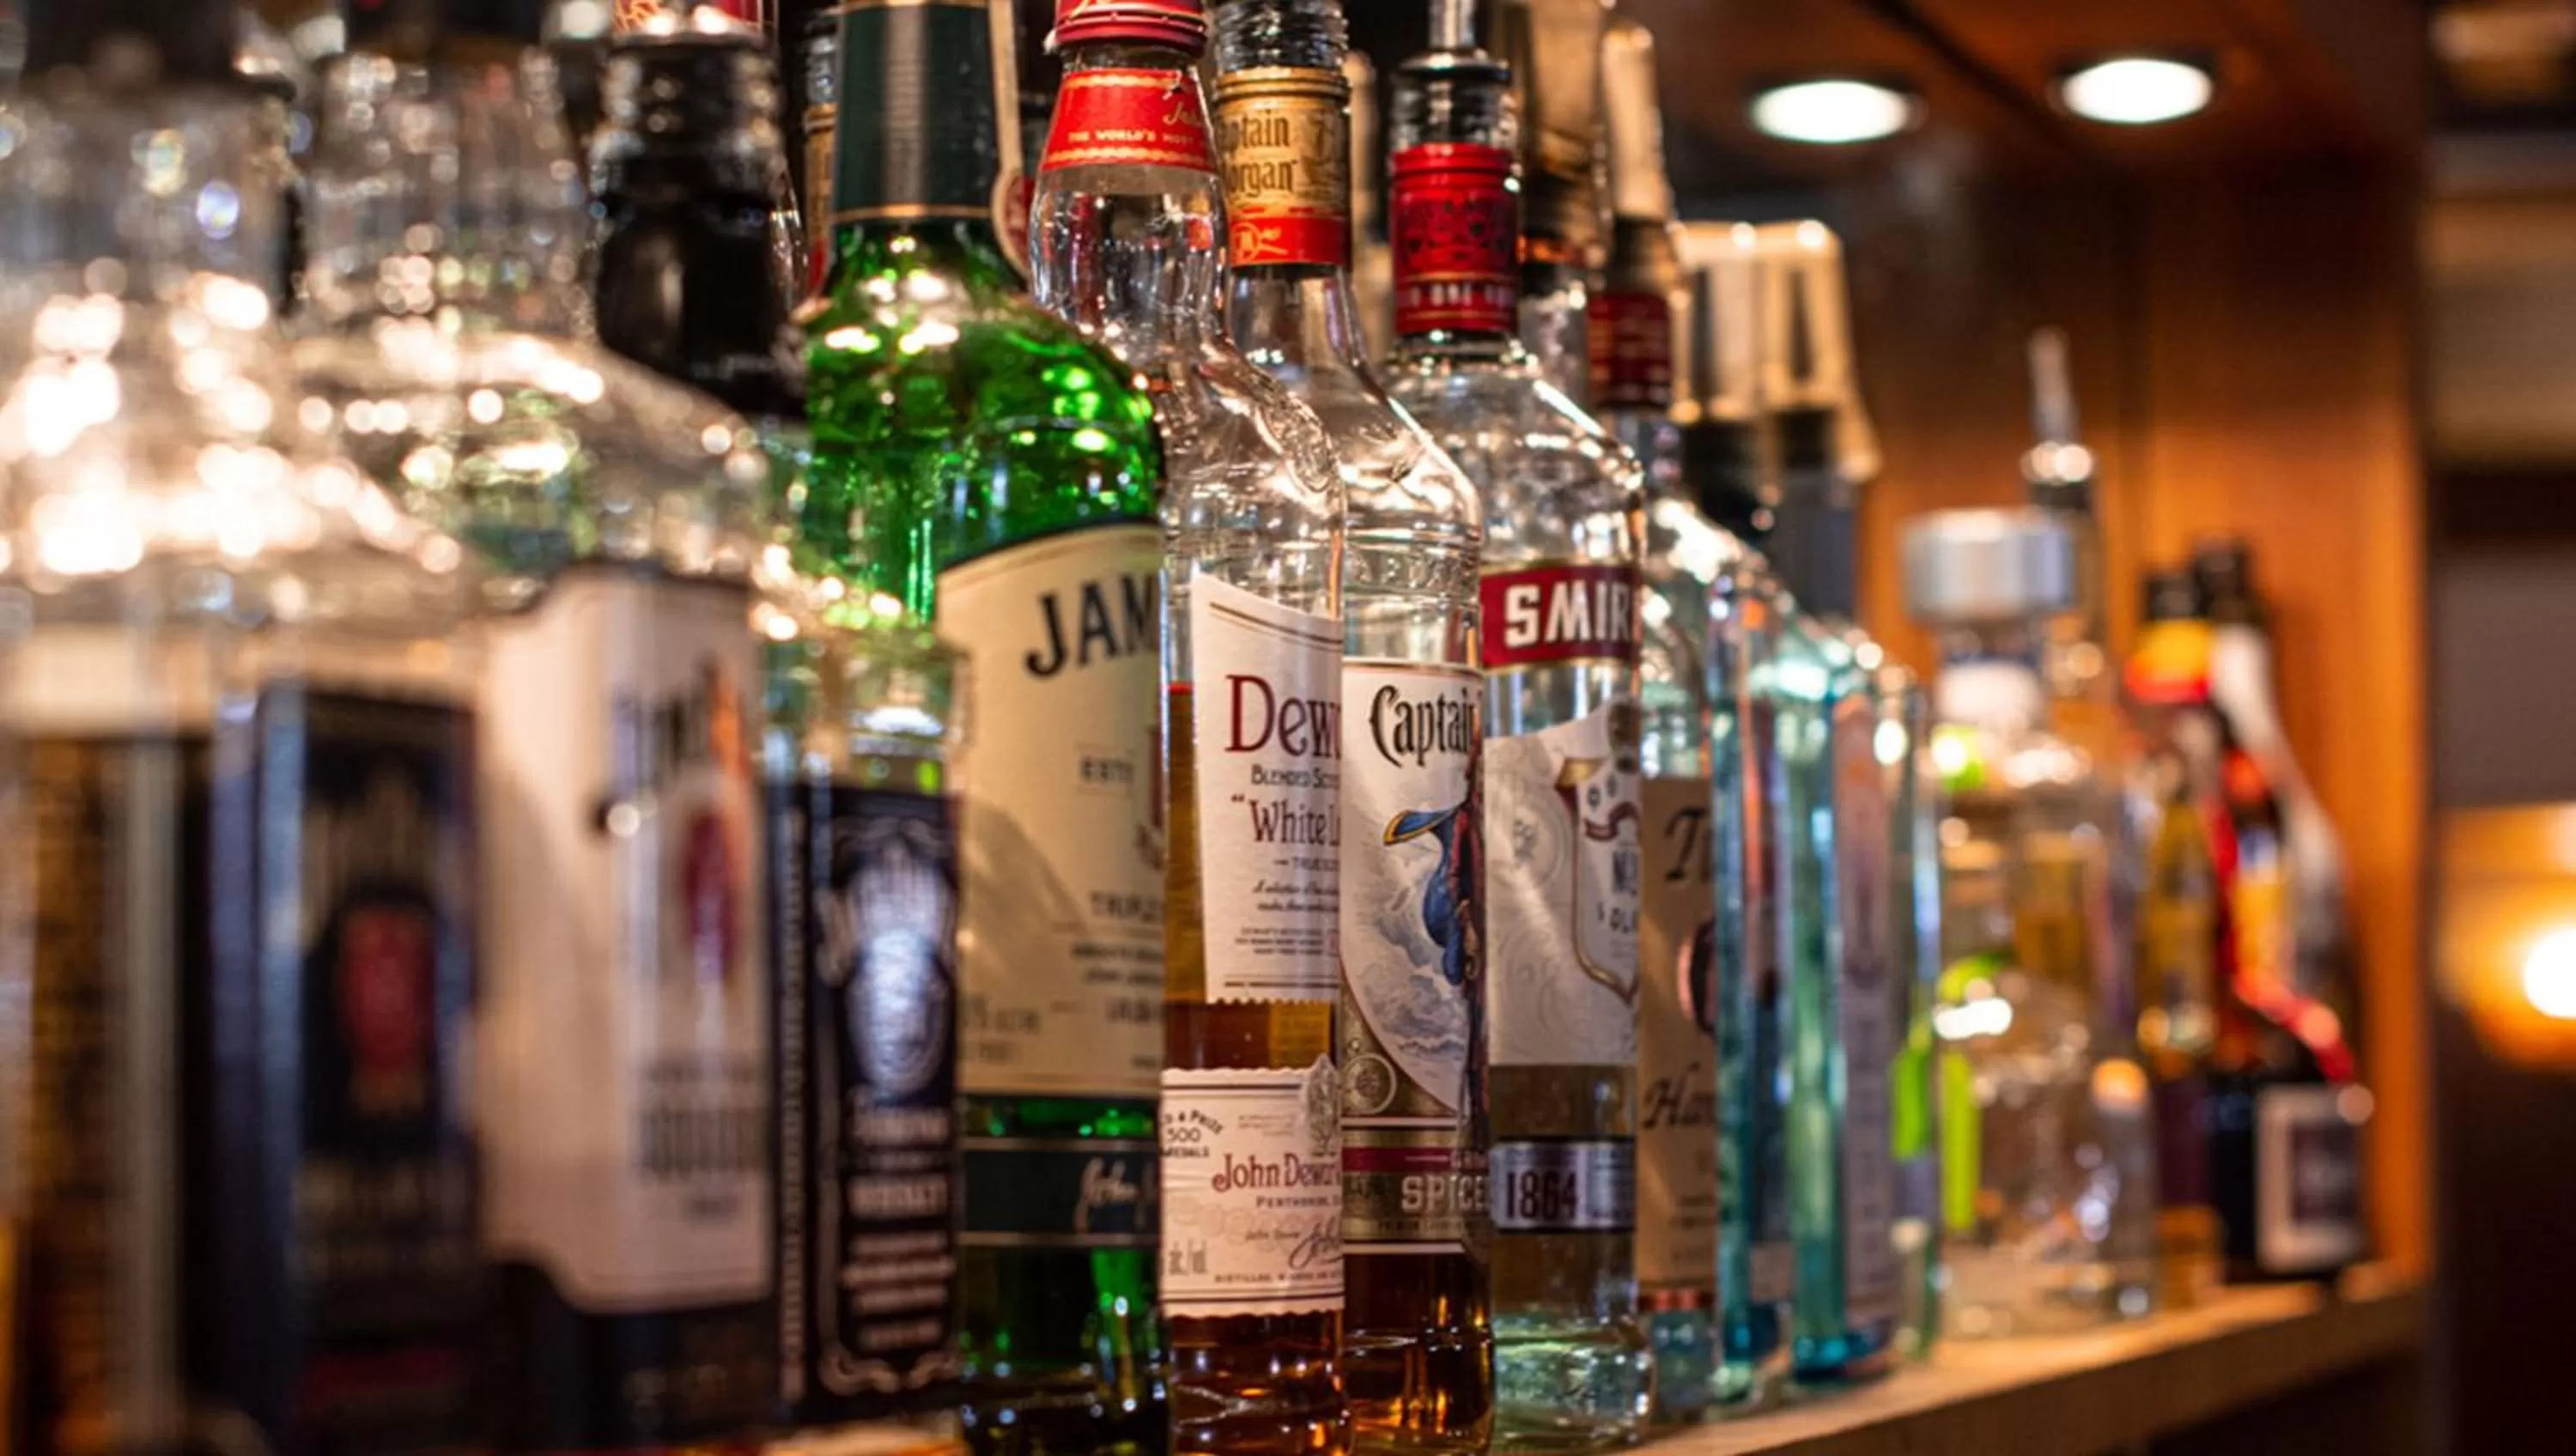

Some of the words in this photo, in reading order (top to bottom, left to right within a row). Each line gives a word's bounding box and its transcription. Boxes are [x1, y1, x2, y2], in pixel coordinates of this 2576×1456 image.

[1504, 579, 1631, 648] SMIR
[1369, 685, 1475, 767] Captai
[1212, 1151, 1281, 1193] John
[1507, 1170, 1577, 1221] 1864
